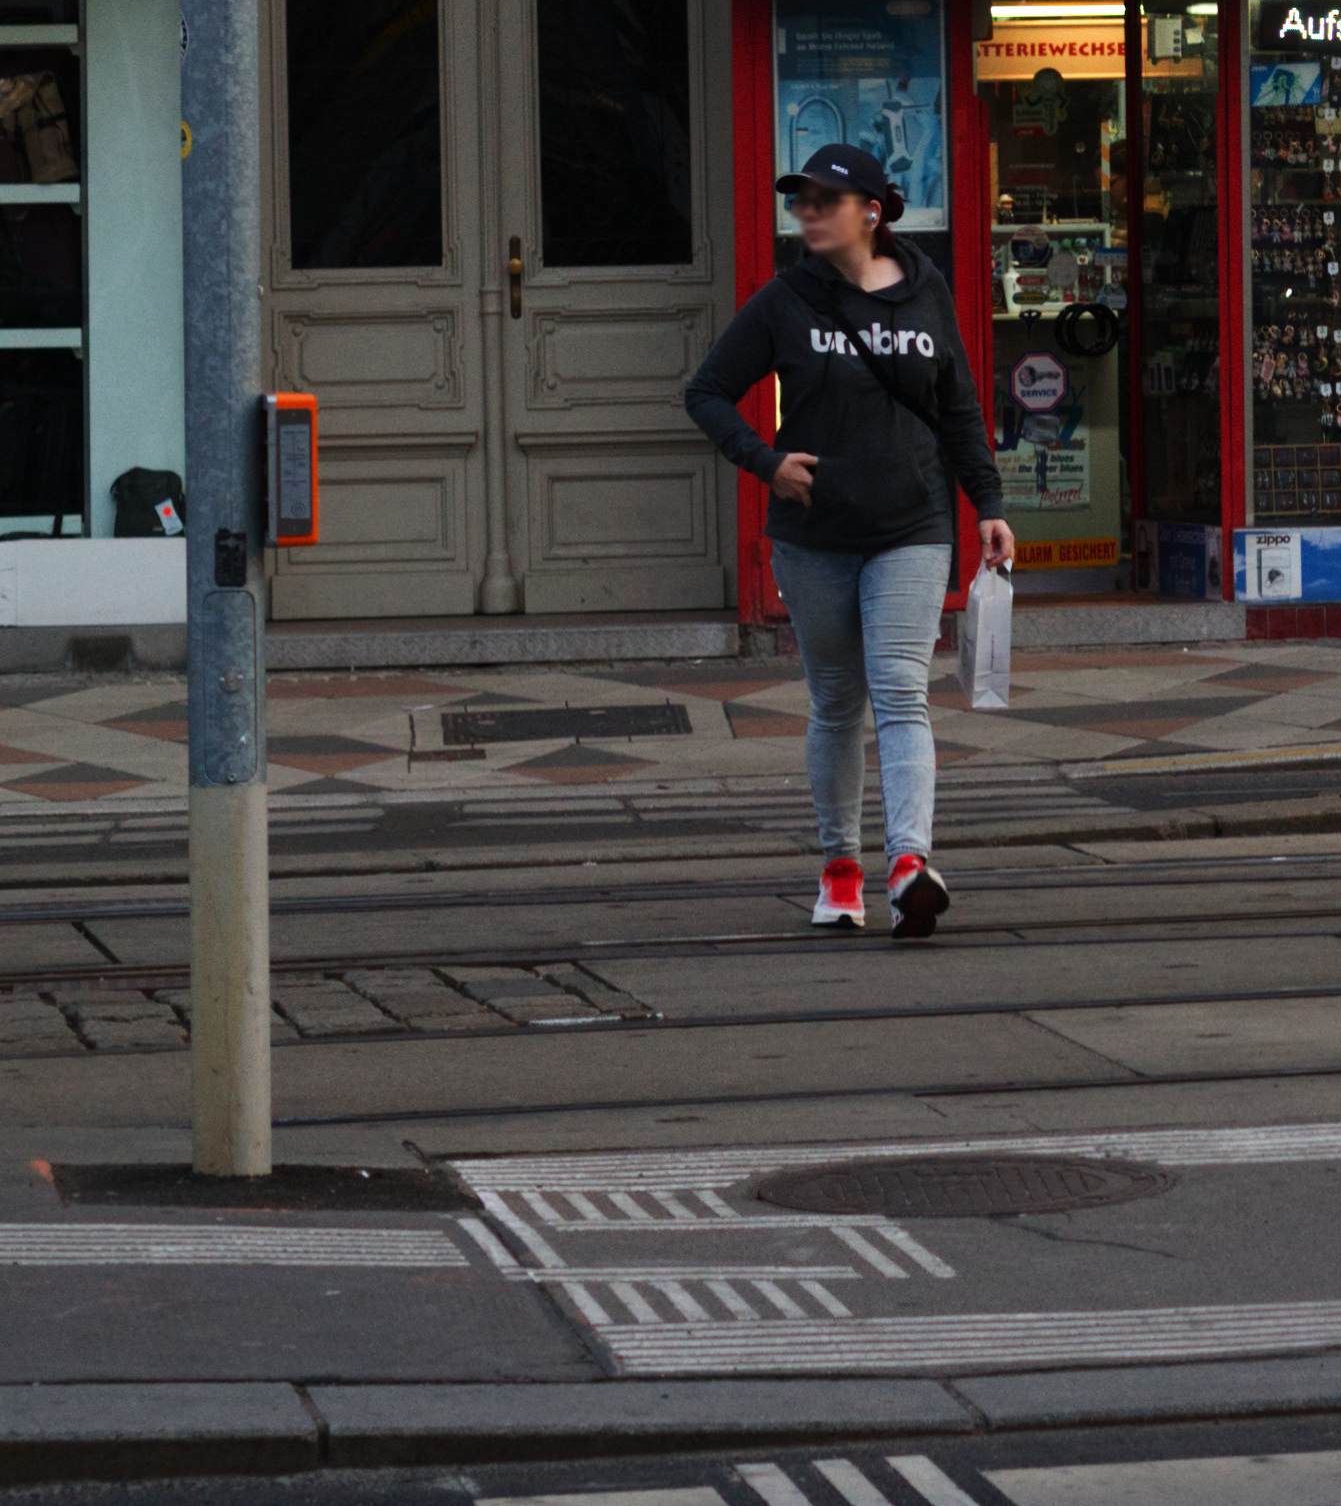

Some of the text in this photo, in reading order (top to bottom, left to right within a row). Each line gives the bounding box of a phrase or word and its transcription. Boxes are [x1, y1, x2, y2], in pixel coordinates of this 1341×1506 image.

[810, 321, 936, 358] umbro
[1020, 388, 1058, 398] SERVICE
[1256, 534, 1291, 546] zippo
[1017, 541, 1116, 564] ALARM GESICHERT
